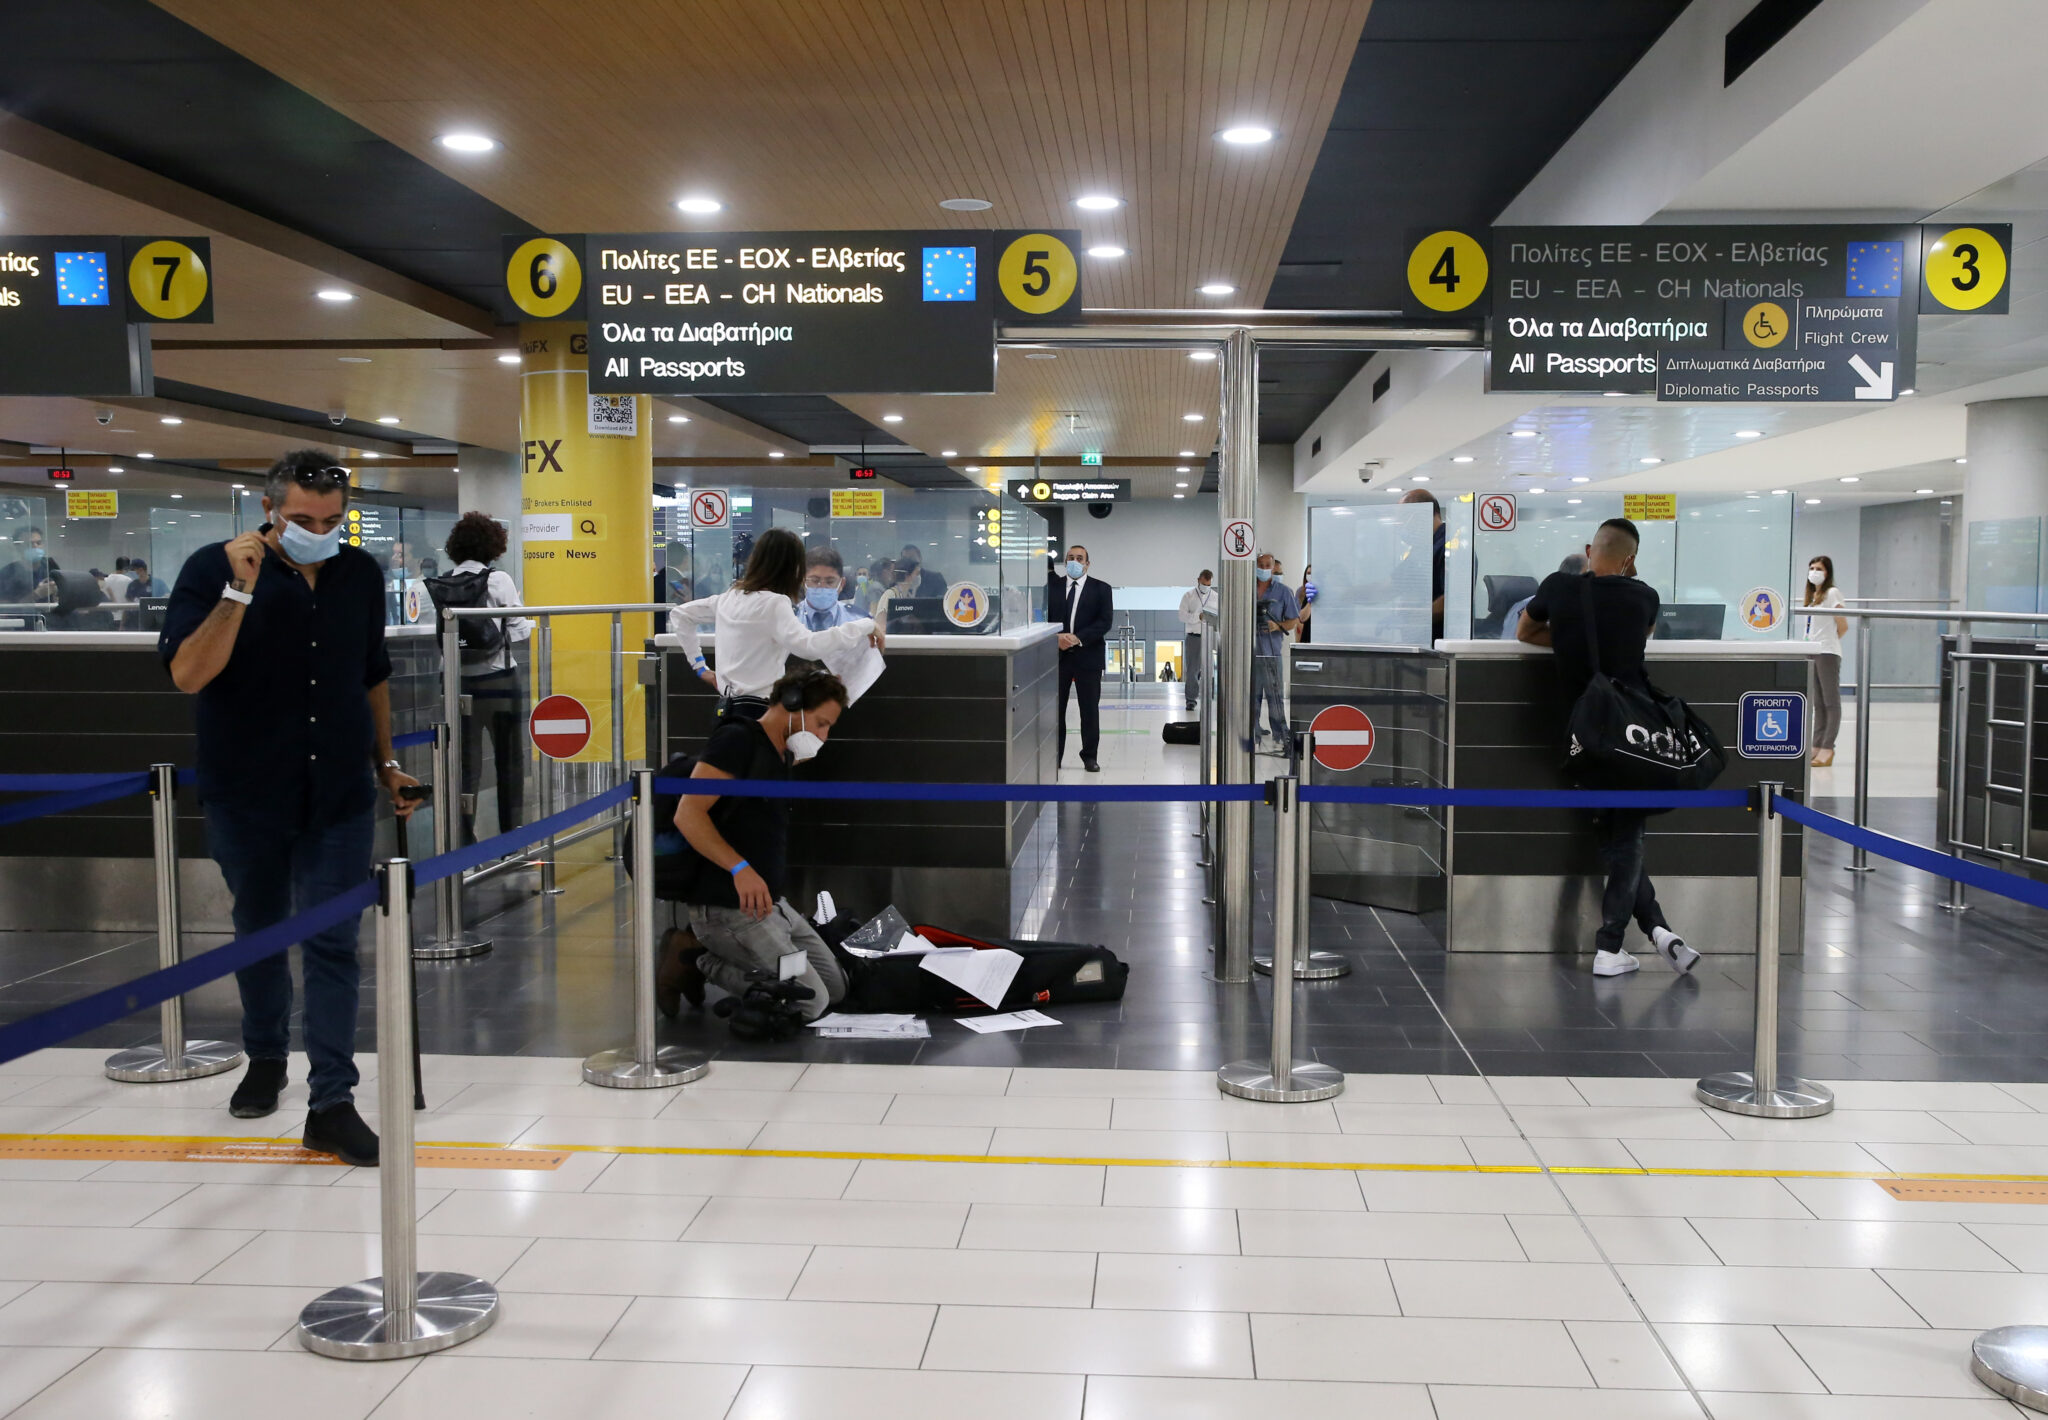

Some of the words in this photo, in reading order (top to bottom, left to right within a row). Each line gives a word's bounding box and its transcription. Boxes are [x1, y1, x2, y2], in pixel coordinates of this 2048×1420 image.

[602, 250, 680, 274] Πολίτες
[686, 248, 718, 270] EE
[740, 248, 790, 268] EOX
[812, 247, 906, 272] Ελβετίας
[1511, 243, 1592, 268] Πολίτες
[1600, 243, 1632, 262] EE
[1656, 242, 1708, 262] EOX
[1731, 242, 1829, 266] Ελβετίας
[152, 256, 180, 300] 7
[528, 252, 557, 298] 6
[1022, 251, 1052, 297] 5
[1429, 247, 1461, 292] 4
[1950, 244, 1980, 292] 3
[602, 284, 632, 305] EU
[665, 284, 710, 304] EEA
[742, 283, 776, 304] CH
[786, 282, 884, 304] Nationals
[1510, 280, 1540, 298] EU
[1576, 279, 1622, 298] EEA
[1658, 278, 1690, 298] CH
[1704, 278, 1804, 298] Nationals
[1806, 306, 1884, 320] Πληρώματα
[602, 322, 646, 342] Όλα
[652, 326, 674, 342] τα
[678, 322, 793, 346] Διαβατήρια
[1508, 318, 1553, 338] Όλα
[1560, 322, 1583, 337] τα
[1588, 317, 1708, 342] Διαβατήρια
[1804, 332, 1844, 346] Flight
[1851, 332, 1889, 344] Crew
[604, 356, 628, 378] All
[640, 356, 746, 381] Passports
[1508, 353, 1534, 373] All
[1547, 353, 1656, 378] Passports
[1666, 358, 1750, 372] Διπλωματικά
[1752, 358, 1826, 372] Διαβατήρια
[1665, 383, 1740, 398] Diplomatic
[1747, 383, 1820, 398] Passports
[529, 523, 560, 533] Provider
[566, 549, 597, 559] News
[1753, 699, 1792, 707] PRIORITY
